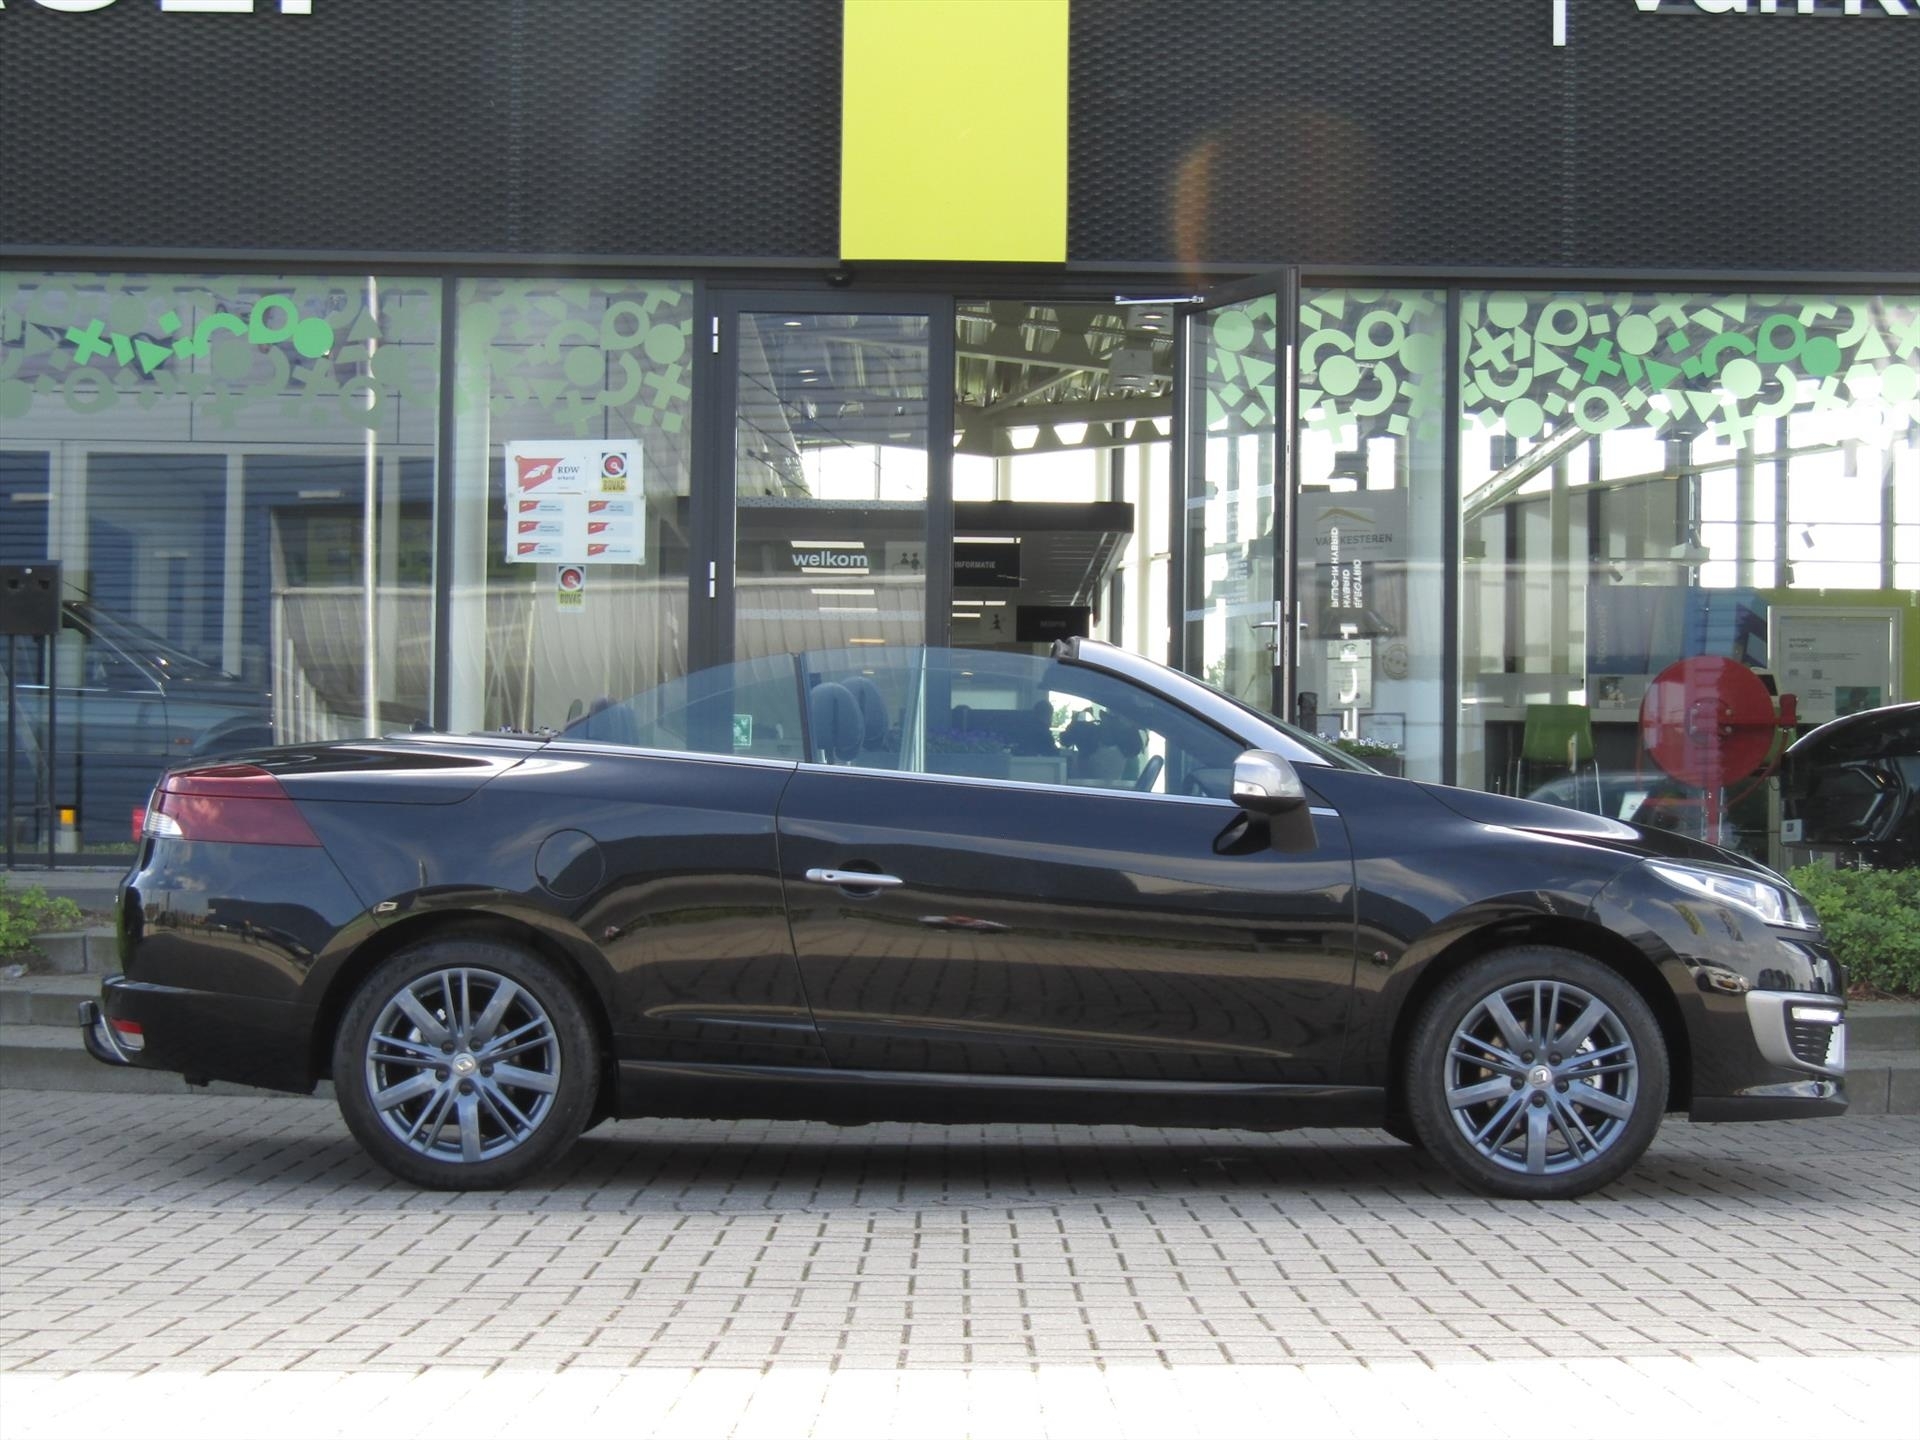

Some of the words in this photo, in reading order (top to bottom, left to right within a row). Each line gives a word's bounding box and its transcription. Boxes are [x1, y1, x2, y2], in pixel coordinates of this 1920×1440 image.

[557, 466, 579, 474] RDW
[1340, 533, 1392, 544] KESTEREN
[792, 551, 868, 566] welkom
[954, 560, 996, 569] INFORMATIE
[559, 592, 582, 604] BOVAG
